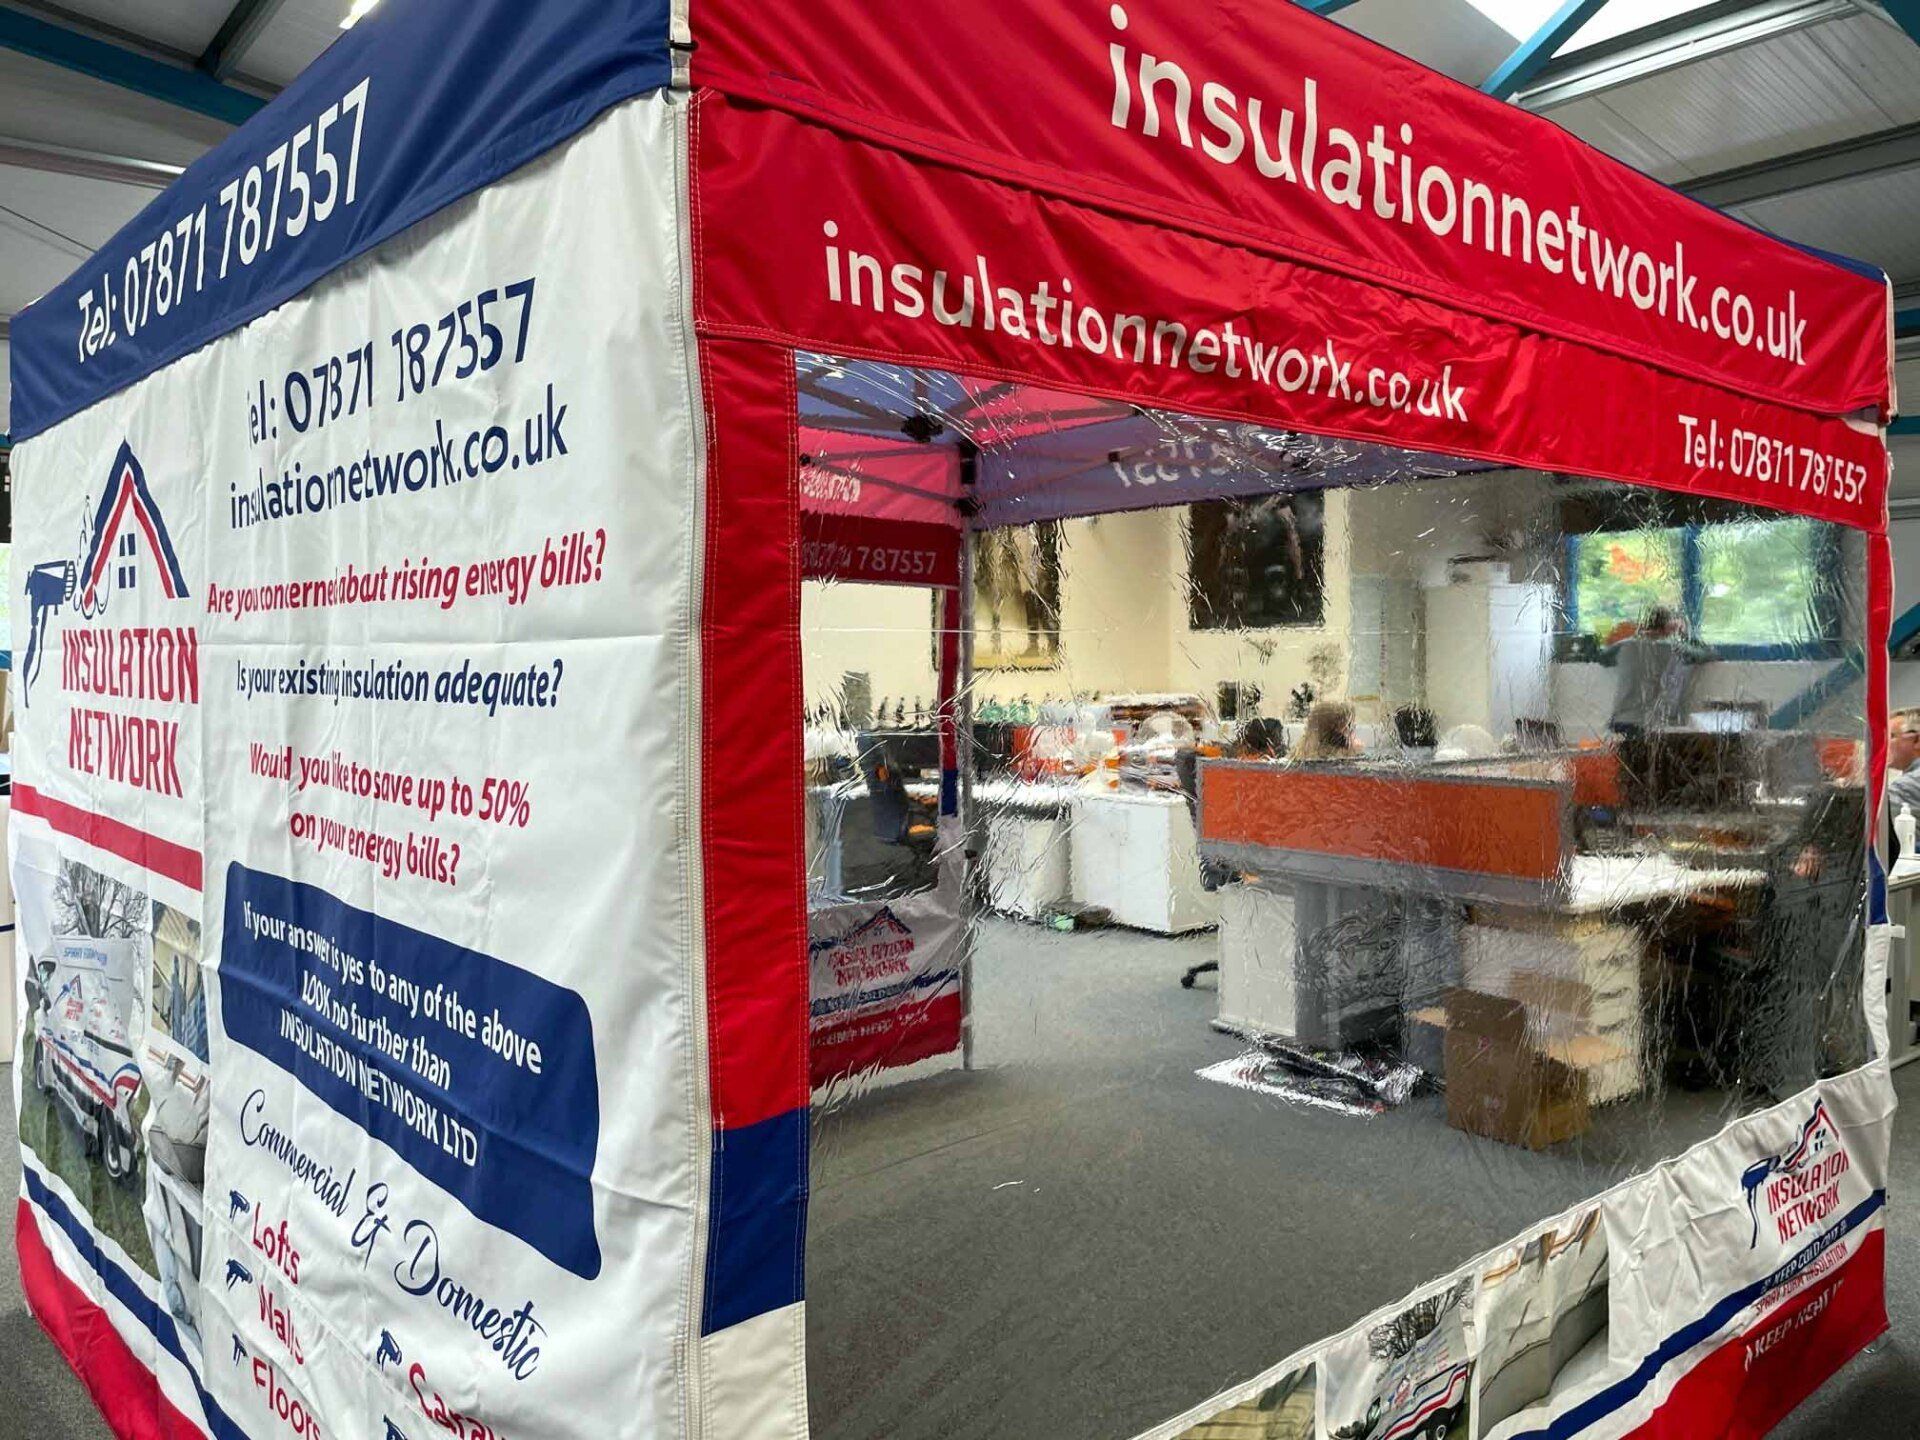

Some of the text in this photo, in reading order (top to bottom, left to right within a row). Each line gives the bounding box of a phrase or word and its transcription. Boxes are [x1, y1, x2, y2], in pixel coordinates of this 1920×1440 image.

[78, 77, 370, 363] Tel: 07871 787557
[1109, 5, 1807, 366] insulationnetwork.co.uk
[823, 220, 1468, 423] insulationnetwork.co.uk
[248, 379, 277, 449] el:
[285, 341, 373, 433] 07871
[1678, 414, 1867, 505] Tel: 07871 787557
[207, 582, 234, 613] Are
[235, 588, 258, 621] you
[391, 557, 460, 609] rising
[465, 554, 537, 605] energy
[540, 528, 606, 588] bills?
[62, 627, 198, 704] INSULATION
[237, 658, 564, 717] Is your existing insulation adequate?
[69, 707, 183, 798] NETWORK
[250, 742, 292, 780] Would
[298, 756, 329, 791] you
[351, 762, 372, 796] to
[373, 768, 412, 805] save
[417, 777, 445, 821] up
[450, 776, 473, 817] to
[478, 777, 530, 828] 50%
[290, 812, 460, 886] on your energy bills?
[243, 900, 542, 1074] If your answer is yes to any of the above
[301, 970, 450, 1090] LOOK no further than
[280, 1008, 477, 1167] INSULATION NETWORK LTD
[240, 1089, 548, 1381] Commercial & Domestic
[252, 1201, 300, 1285] Lofts
[1777, 1180, 1840, 1244] NETWORK
[1755, 1318, 1792, 1358] KEEP
